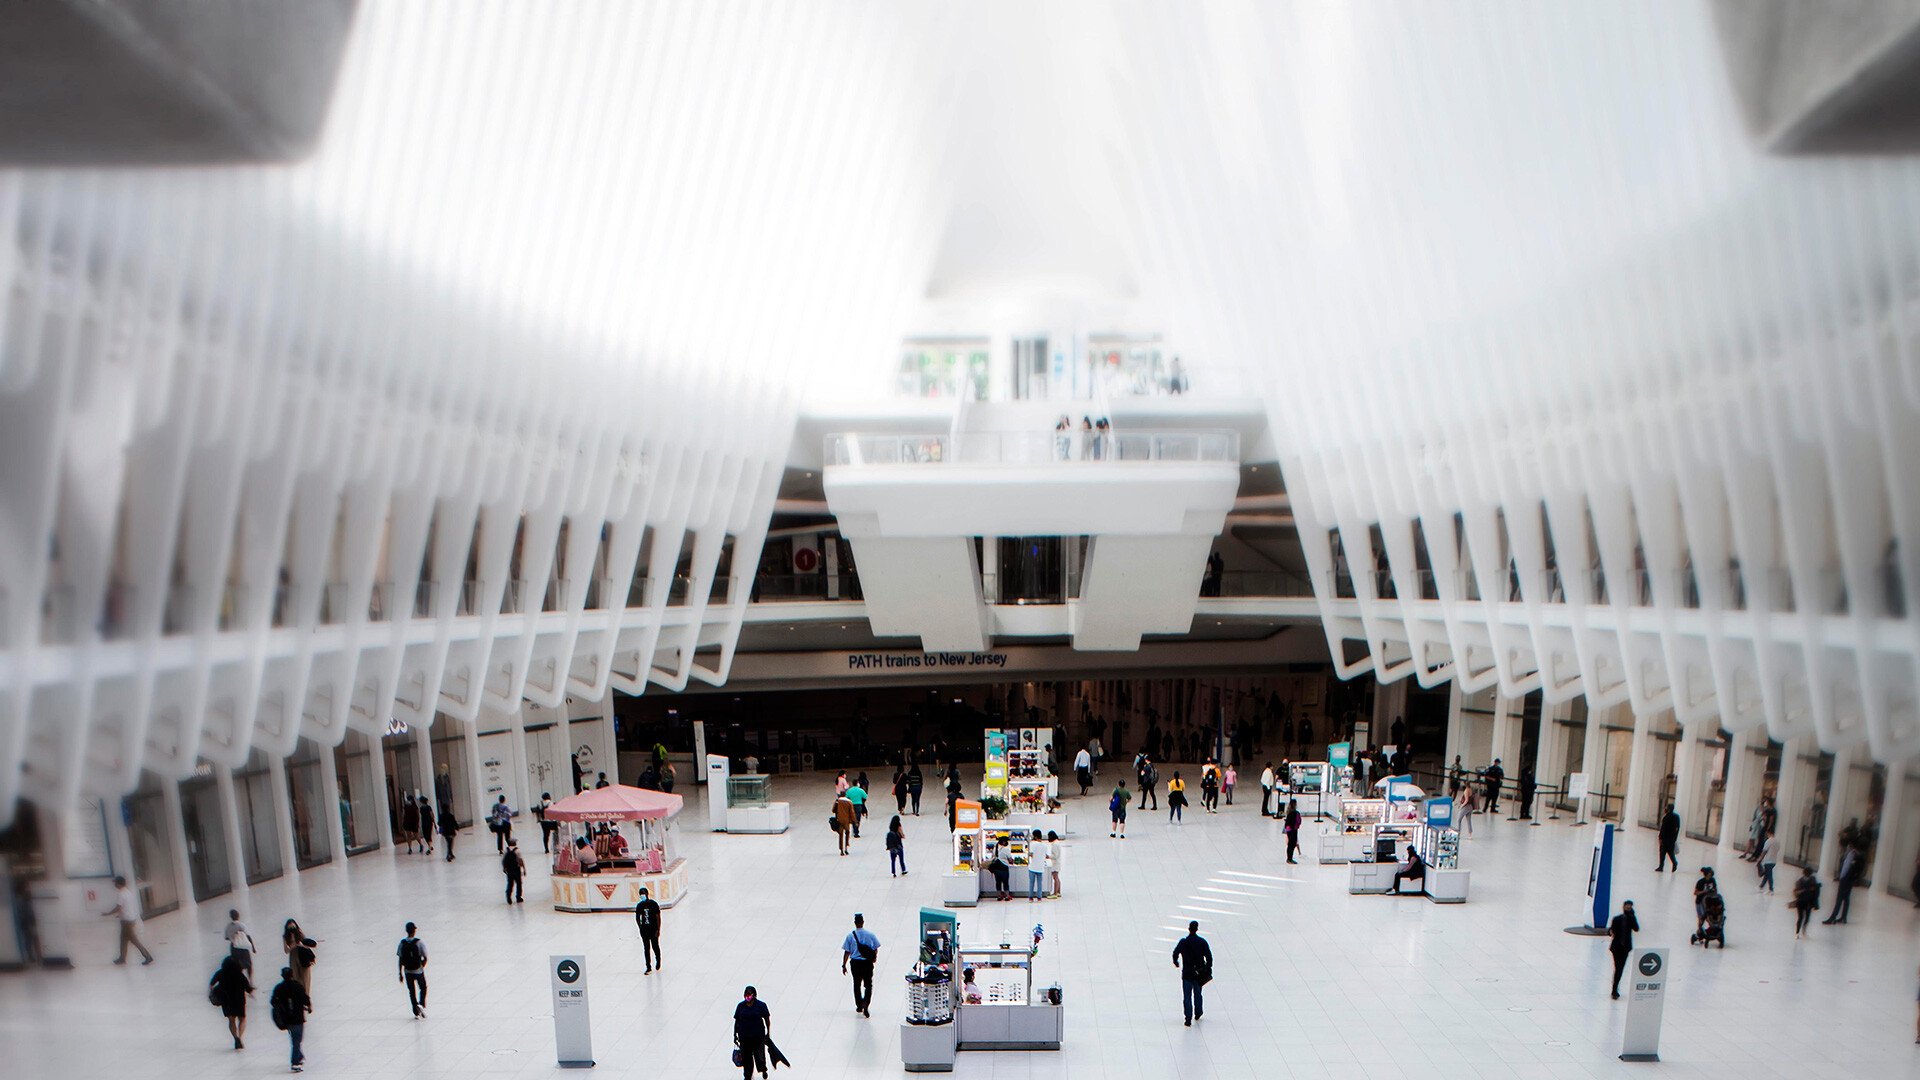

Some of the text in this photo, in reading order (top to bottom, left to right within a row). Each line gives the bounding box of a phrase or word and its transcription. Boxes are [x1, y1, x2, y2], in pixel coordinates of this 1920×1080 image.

[849, 652, 1007, 668] PATH trains to New Jersey
